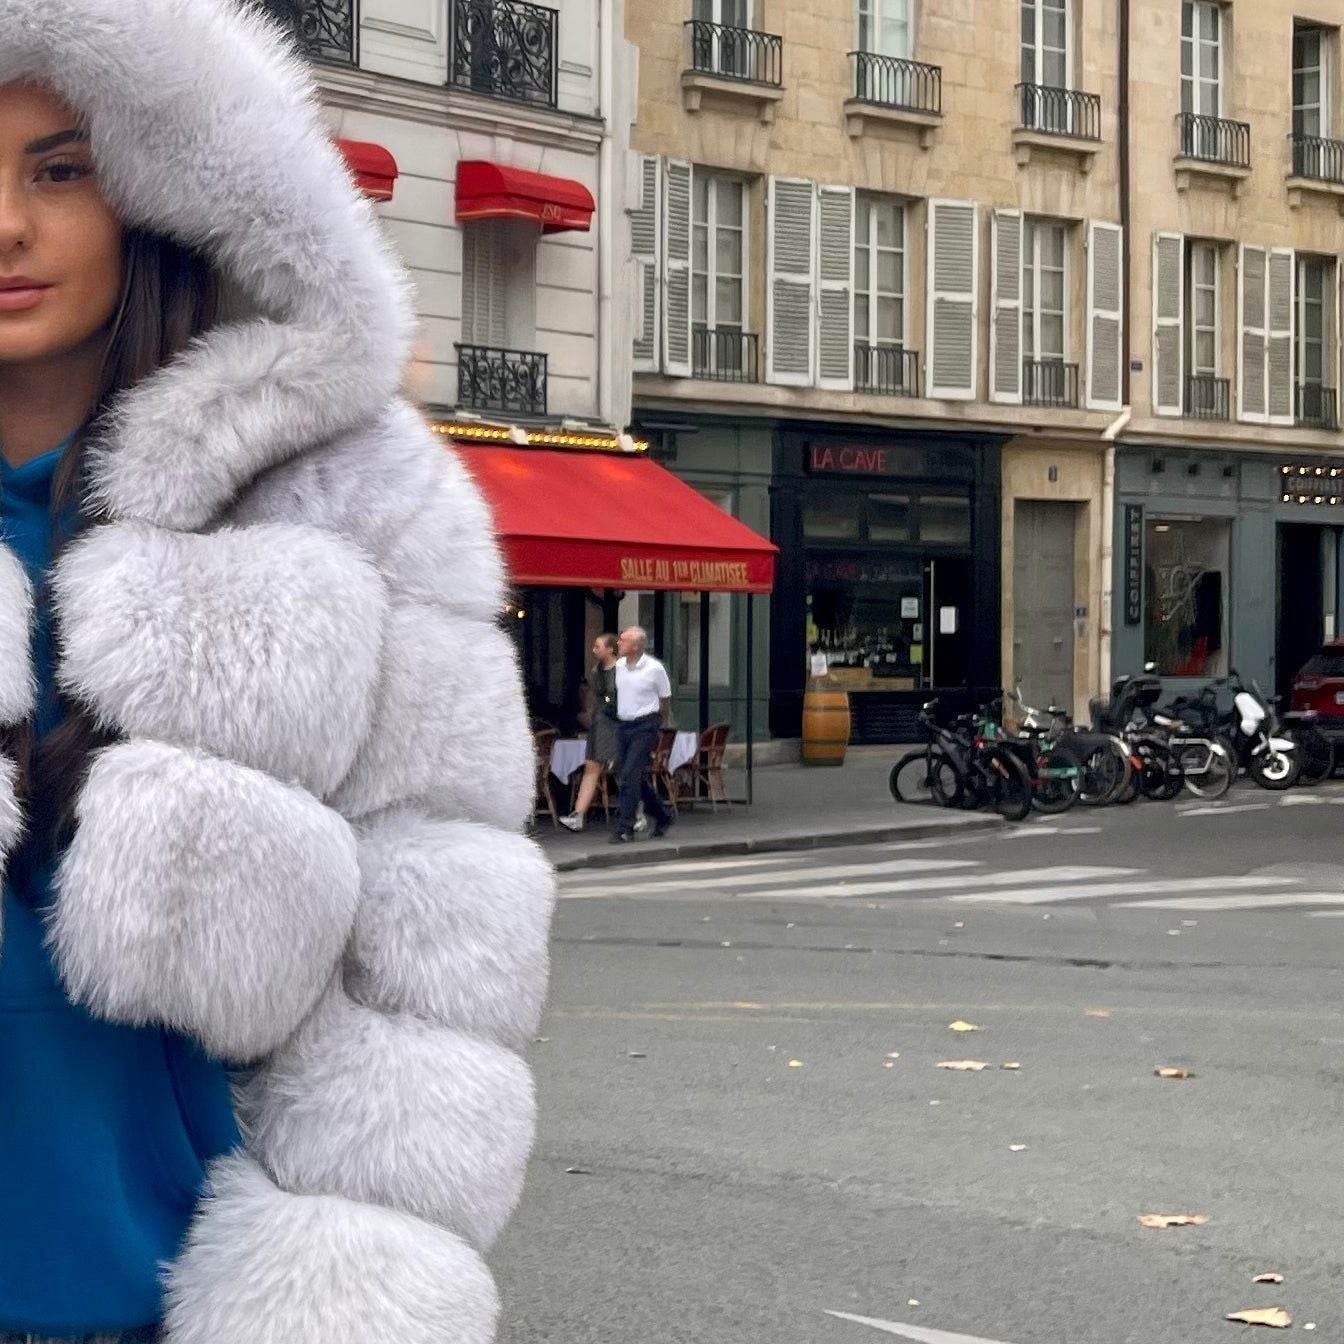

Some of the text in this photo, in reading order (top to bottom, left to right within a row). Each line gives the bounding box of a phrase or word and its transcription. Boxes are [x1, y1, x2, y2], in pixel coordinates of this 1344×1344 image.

[812, 447, 887, 472] LA CAVE
[620, 558, 653, 581] SALLE
[656, 559, 669, 581] AU
